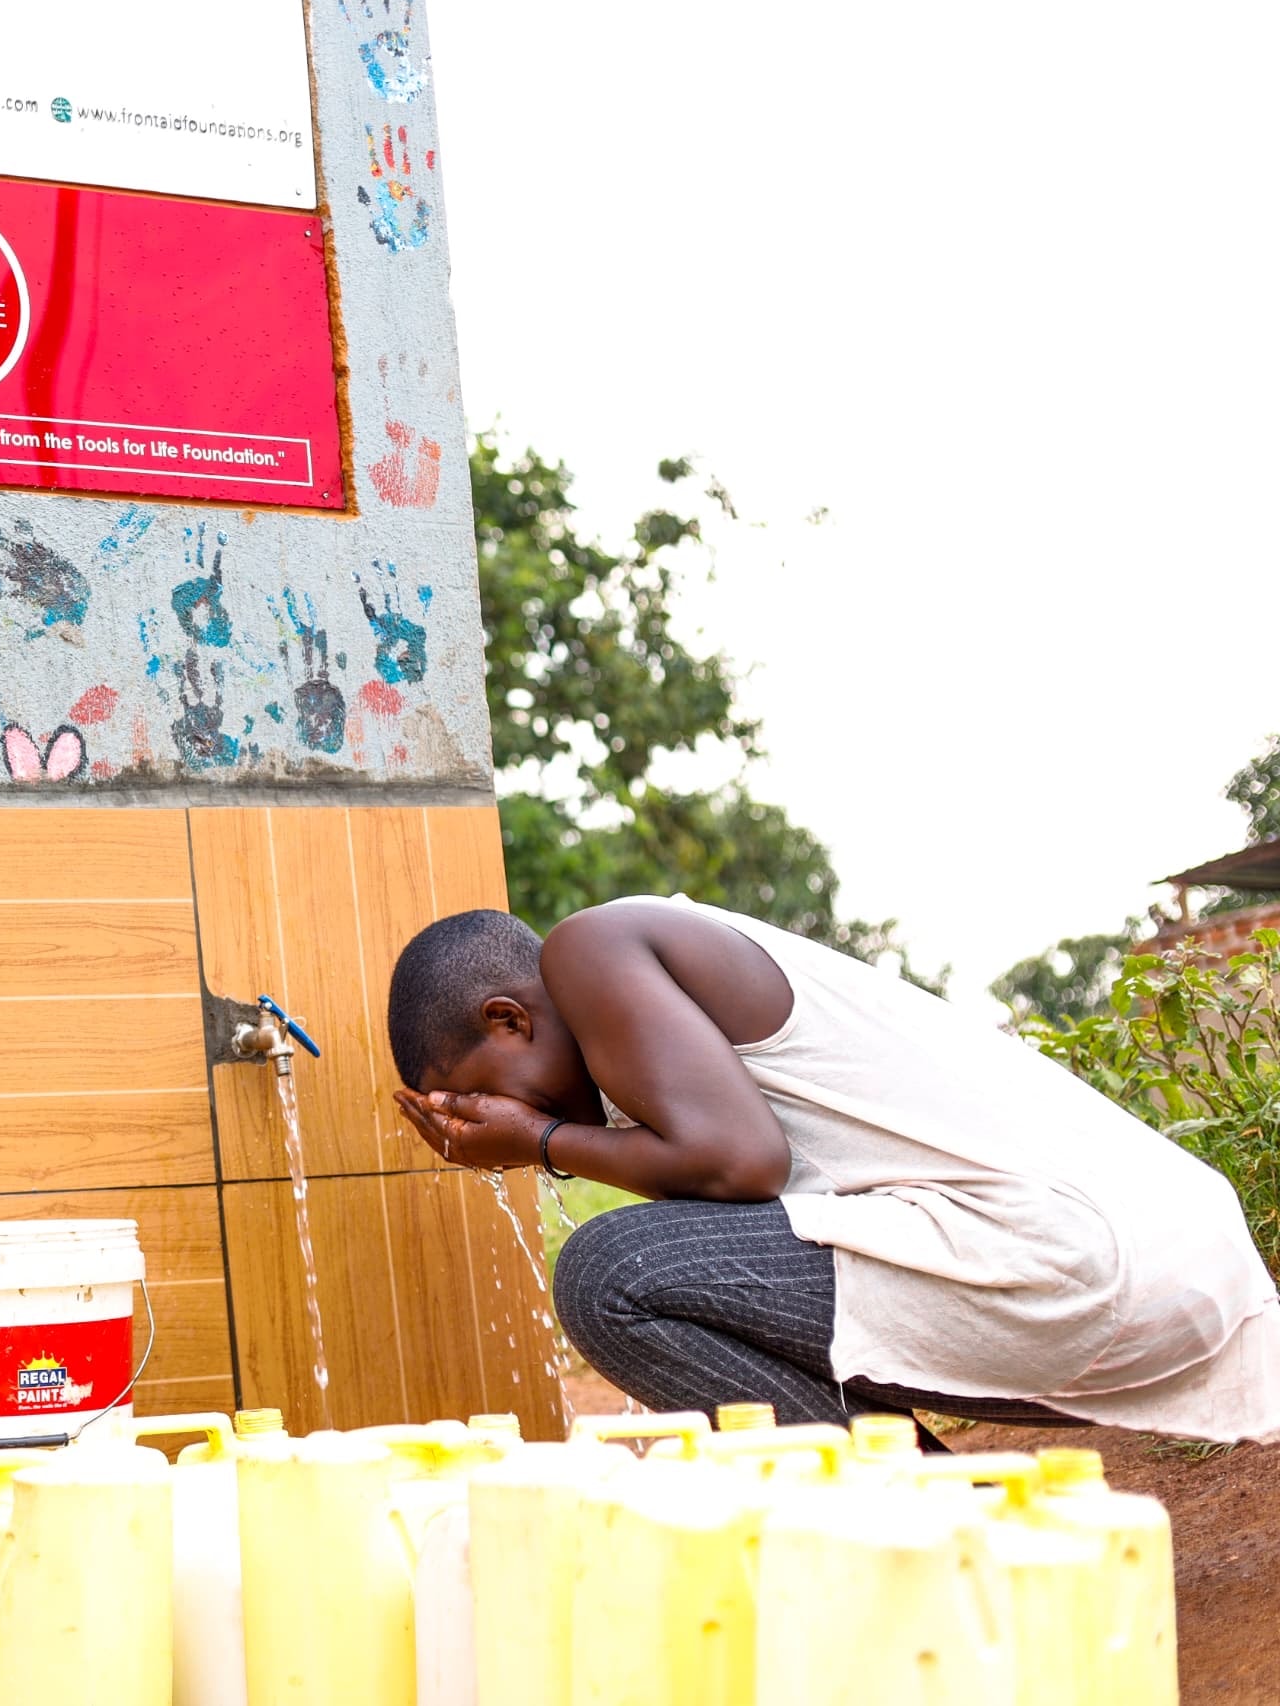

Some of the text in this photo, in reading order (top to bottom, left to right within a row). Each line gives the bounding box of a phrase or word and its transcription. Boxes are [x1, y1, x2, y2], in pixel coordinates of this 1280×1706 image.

[76, 106, 303, 148] www.frontaidfoundations.org
[0, 428, 41, 449] from
[44, 431, 73, 450] the
[76, 435, 120, 455] Tools
[123, 438, 146, 457] for
[150, 440, 179, 459] Life
[183, 444, 286, 468] Foundation."
[20, 1371, 65, 1385] REGAL
[18, 1388, 68, 1404] PAINTS
